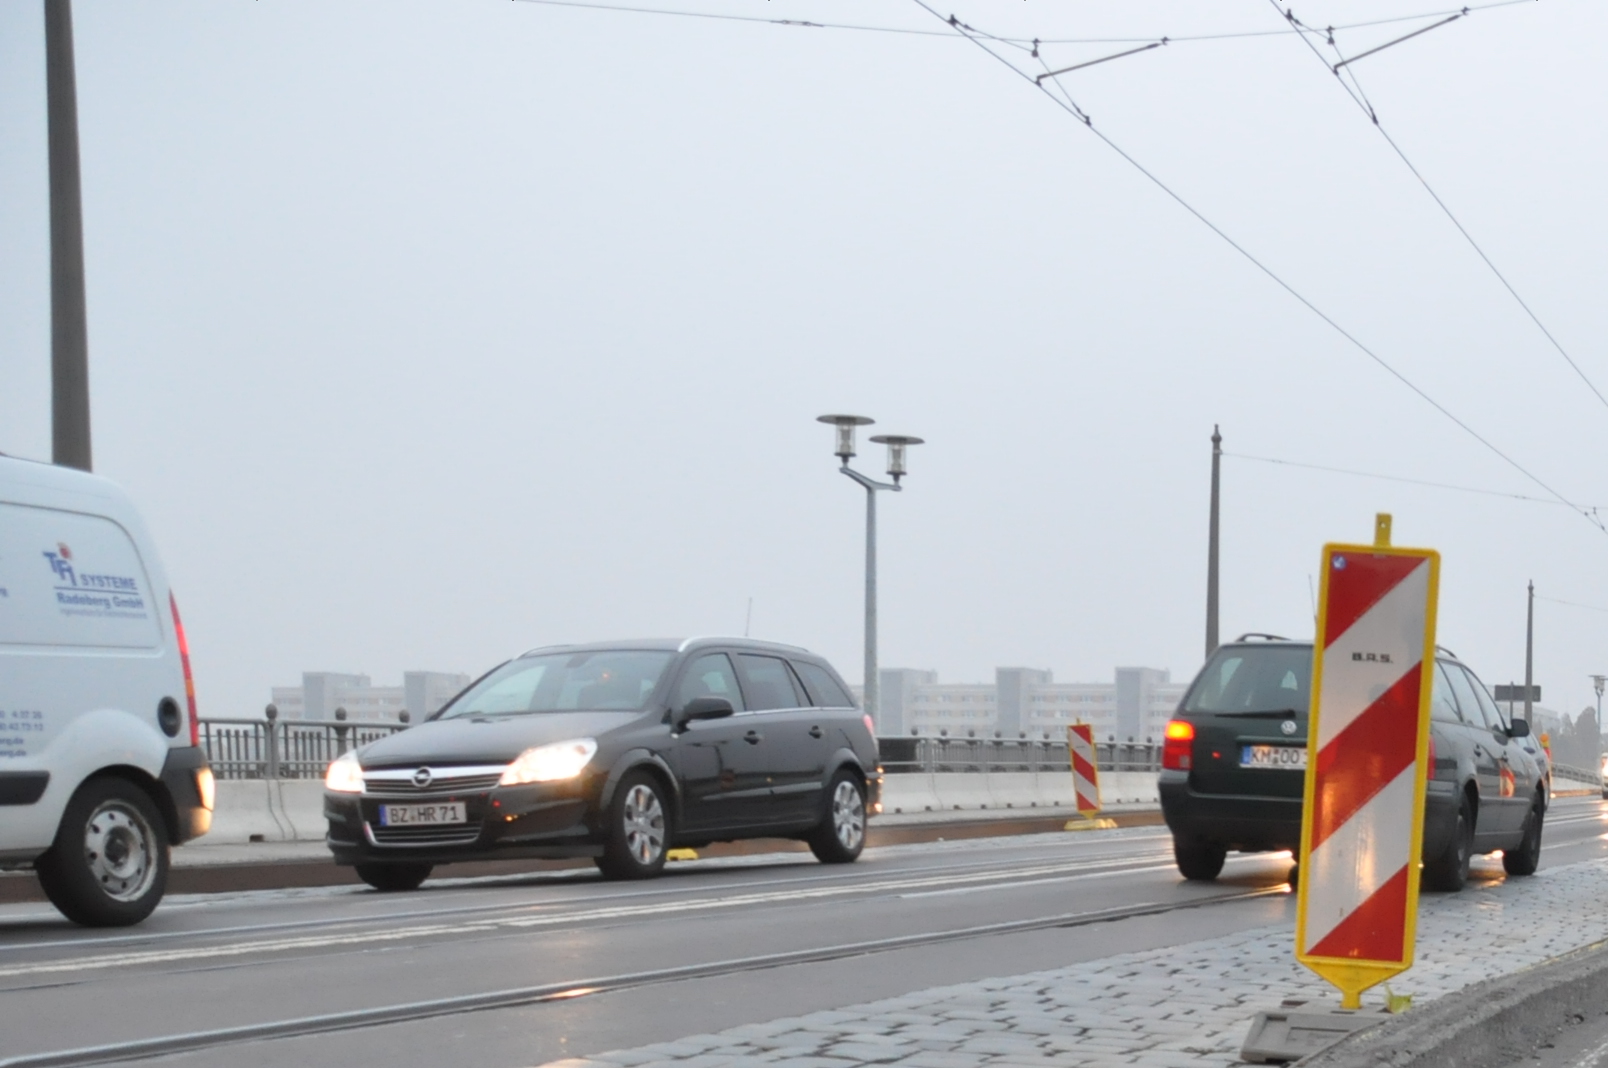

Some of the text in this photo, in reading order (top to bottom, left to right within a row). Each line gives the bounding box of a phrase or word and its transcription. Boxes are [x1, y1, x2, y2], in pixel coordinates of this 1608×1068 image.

[80, 573, 138, 590] SYSTEME
[56, 592, 144, 609] Radeberg GmbH
[1252, 748, 1271, 763] KM
[391, 806, 459, 823] BZ HR 71
